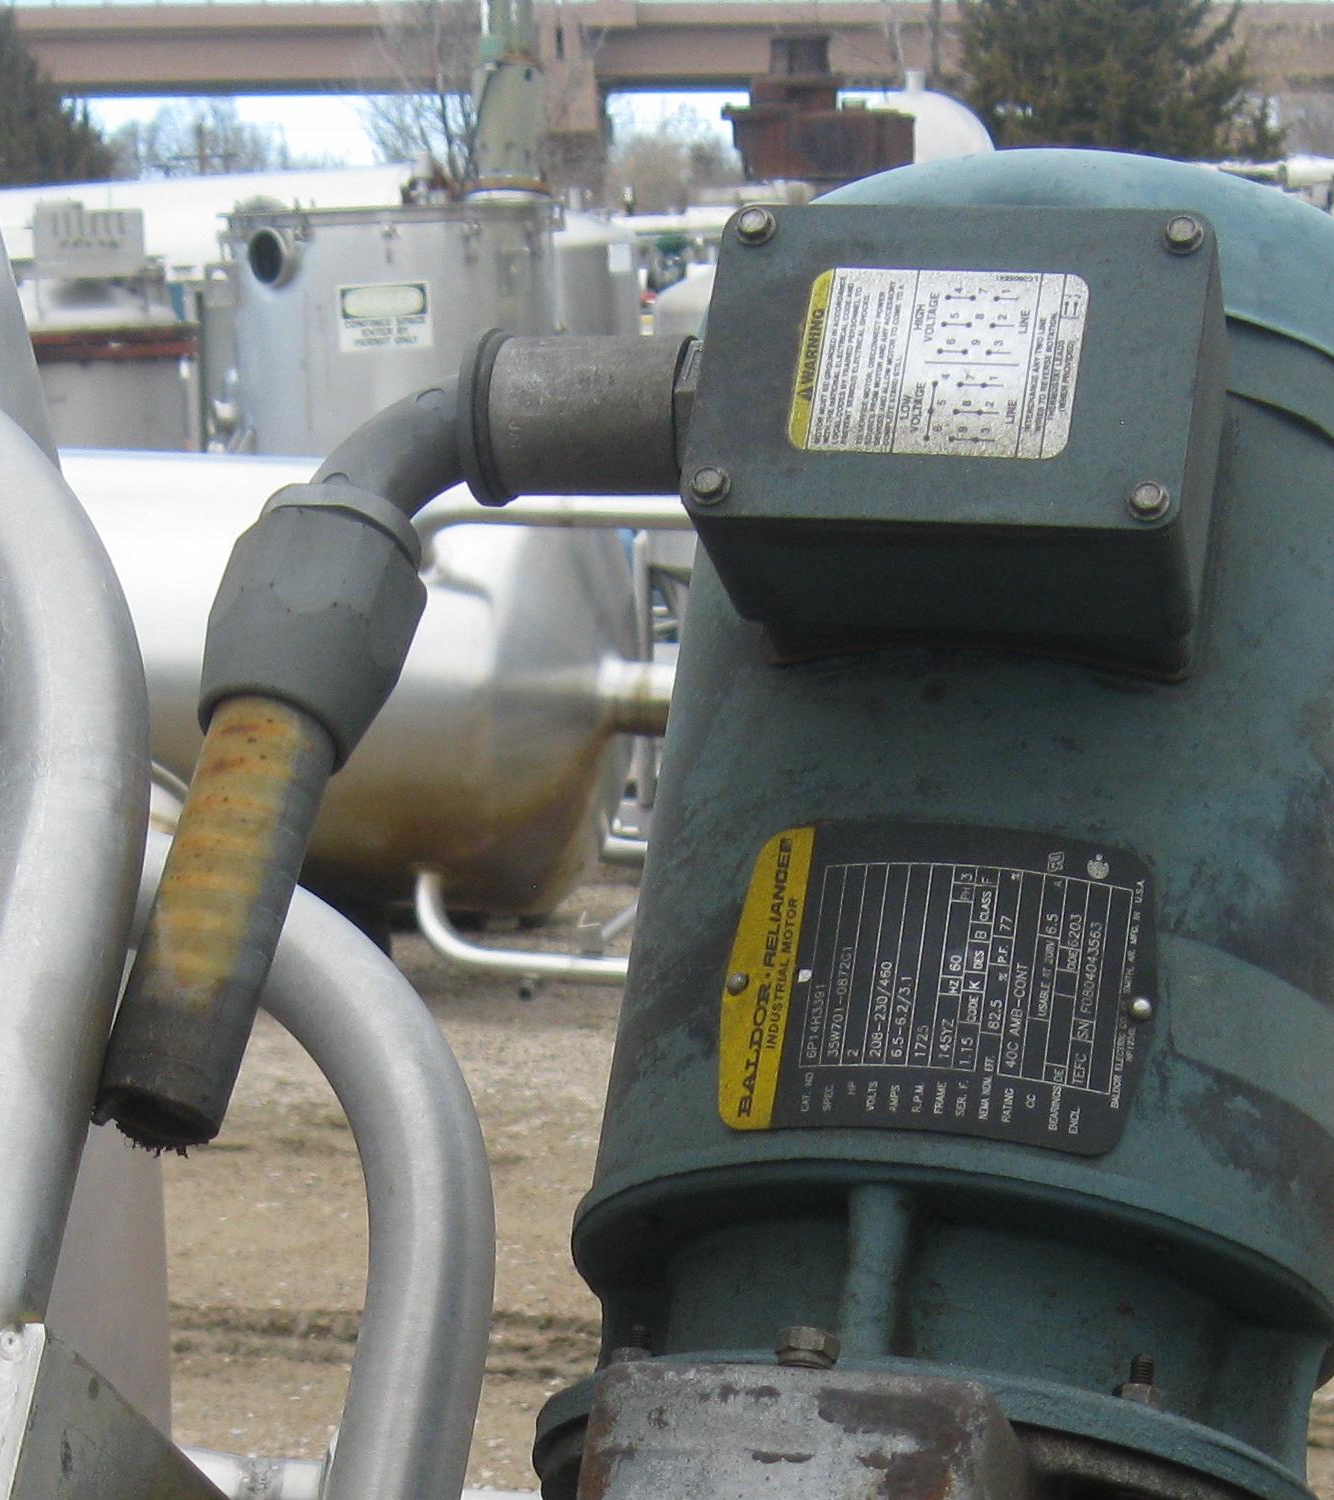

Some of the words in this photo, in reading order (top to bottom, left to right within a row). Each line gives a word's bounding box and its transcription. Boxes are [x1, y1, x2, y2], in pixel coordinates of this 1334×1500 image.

[875, 291, 885, 318] POWER
[913, 304, 925, 329] HIGH
[923, 293, 939, 341] VOLTAGE
[834, 324, 847, 367] ELECTRICAL
[845, 282, 853, 297] AND
[842, 345, 852, 376] TRAINED
[855, 286, 861, 296] TO
[1018, 309, 1030, 333] LINE
[394, 336, 417, 344] ONLY
[801, 308, 824, 383] WARNING
[851, 329, 864, 372] ELECTRICAL
[878, 395, 886, 411] AND
[890, 327, 897, 336] TO
[896, 291, 903, 300] TO
[1035, 337, 1043, 353] TWO
[824, 338, 836, 379] GROUNDED
[873, 361, 883, 387] MOTOR
[880, 327, 888, 341] ANY
[1032, 357, 1040, 371] ANY
[899, 395, 911, 419] LOW
[909, 382, 925, 432] VOLTAGE
[1005, 399, 1017, 424] LINE
[1038, 393, 1045, 404] TO
[960, 872, 972, 880] 3
[960, 887, 970, 899] PH
[979, 891, 991, 920] CLASS
[999, 915, 1012, 931] 77
[1044, 913, 1058, 934] 6.5
[1132, 911, 1140, 920] IN
[1067, 913, 1082, 947] 6203
[949, 955, 962, 970] 60
[972, 950, 984, 969] DES
[1043, 939, 1055, 964] 208V
[766, 959, 788, 1048] INDUSTRIAL
[781, 897, 798, 953] MOTOR
[968, 980, 980, 989] K
[1042, 967, 1051, 977] AT
[948, 980, 958, 993] HZ
[987, 999, 1002, 1029] 82.5
[997, 972, 1007, 981] %
[1008, 963, 1028, 1036] AMB-CONT
[1036, 982, 1049, 1016] USABLE
[869, 961, 893, 1056] 208-230/460
[890, 976, 912, 1057] 6.5-6.2/3.1
[966, 995, 979, 1021] CODE
[914, 1024, 929, 1056] 1725
[938, 1018, 954, 1057] 145YZ
[1076, 1021, 1089, 1040] SN
[738, 981, 770, 1117] BALDOR
[959, 1036, 973, 1064] 1.15
[1004, 1041, 1018, 1068] 40C
[1114, 1032, 1126, 1071] ELECTRIC
[1053, 1068, 1064, 1081] DE
[1071, 1052, 1086, 1084] TEFC
[847, 1081, 857, 1094] HP
[865, 1080, 878, 1110] VOLTS
[887, 1084, 900, 1112] AMPS
[933, 1081, 946, 1113] FRAME
[1110, 1074, 1121, 1108] BALDOR
[977, 1097, 989, 1119] NEMA
[1000, 1087, 1014, 1122] RATING
[1047, 1085, 1062, 1130] BEARINGS
